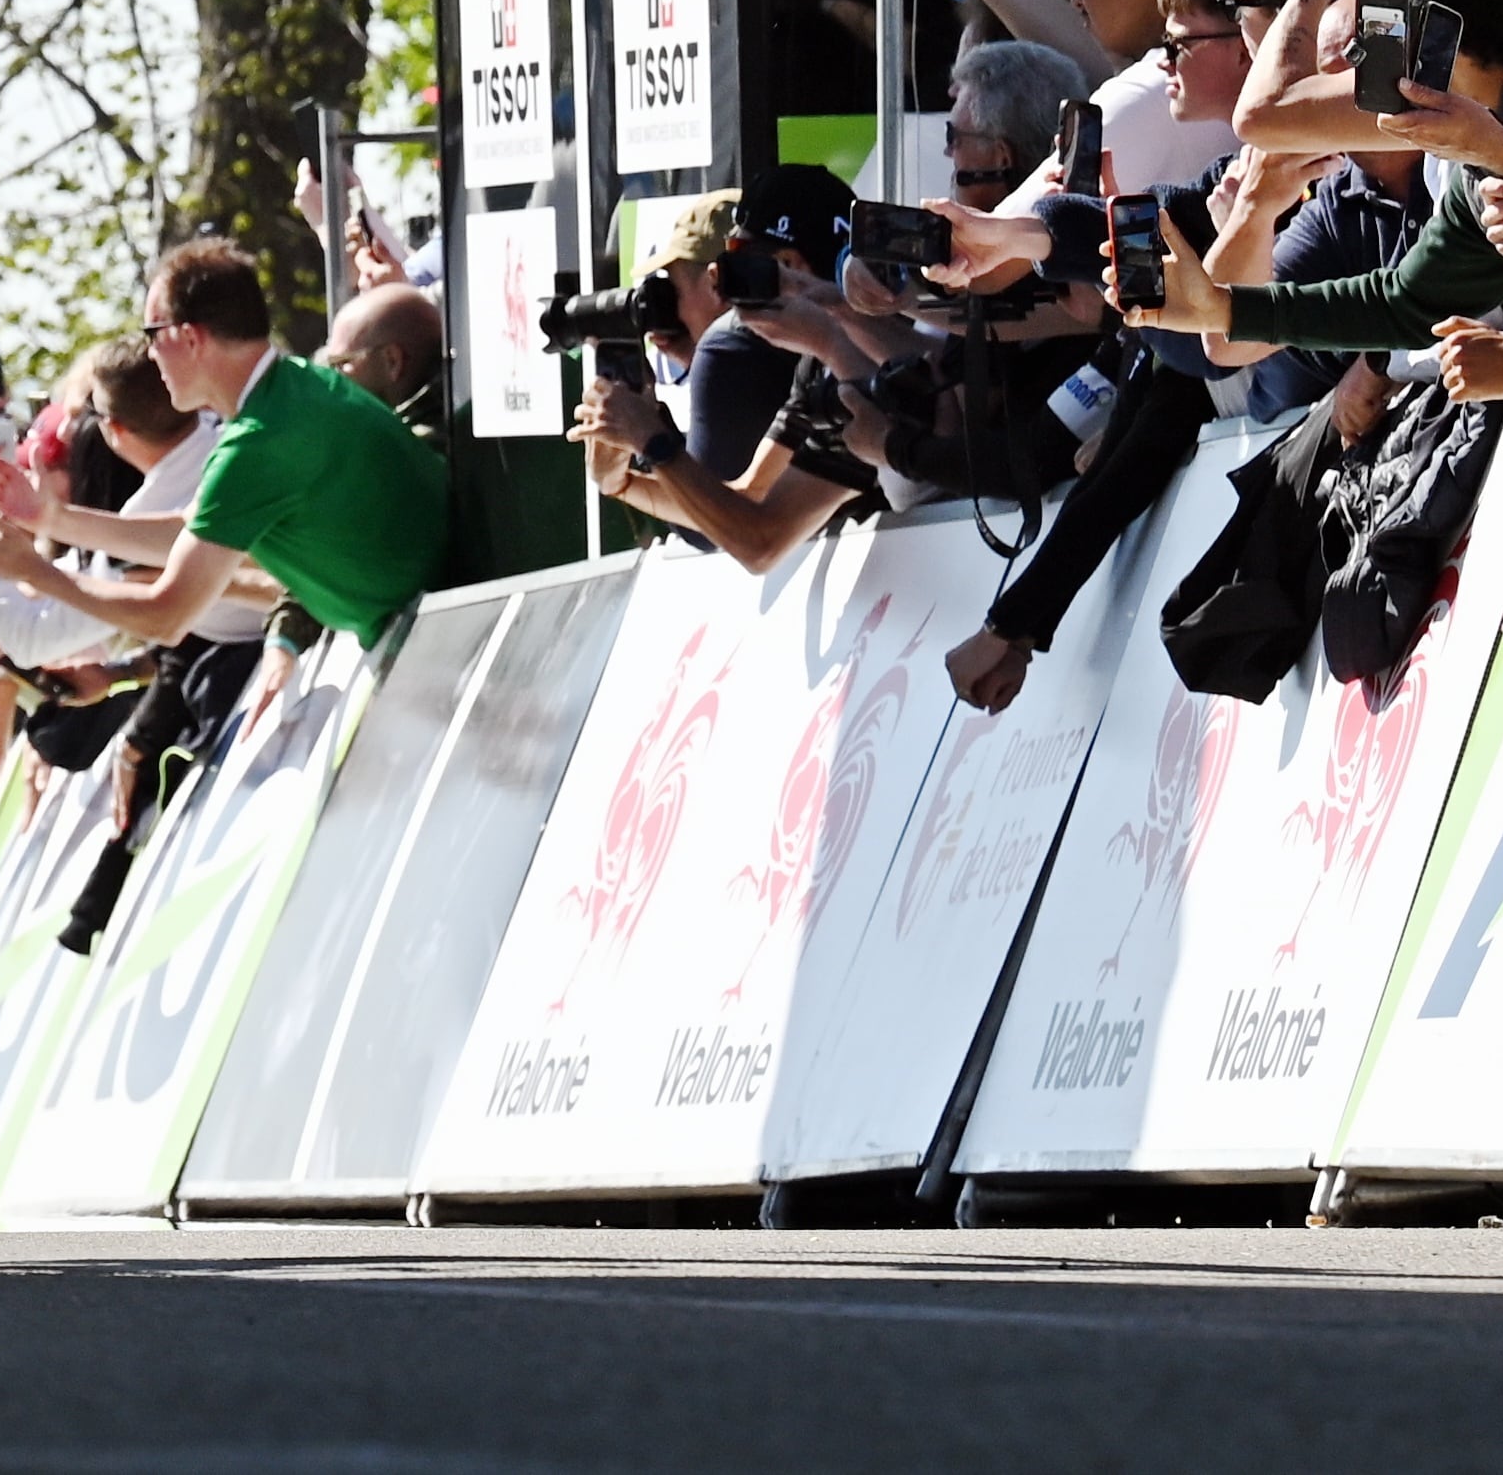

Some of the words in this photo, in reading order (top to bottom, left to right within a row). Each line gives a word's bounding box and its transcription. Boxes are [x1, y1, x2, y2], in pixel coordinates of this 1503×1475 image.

[472, 61, 539, 128] TISSOT
[625, 41, 698, 112] TISSOT
[486, 1029, 590, 1119] Wallonie
[655, 1015, 773, 1109] Wallonie
[1031, 991, 1145, 1092] Wallonie
[1206, 985, 1327, 1083] Wallonie
